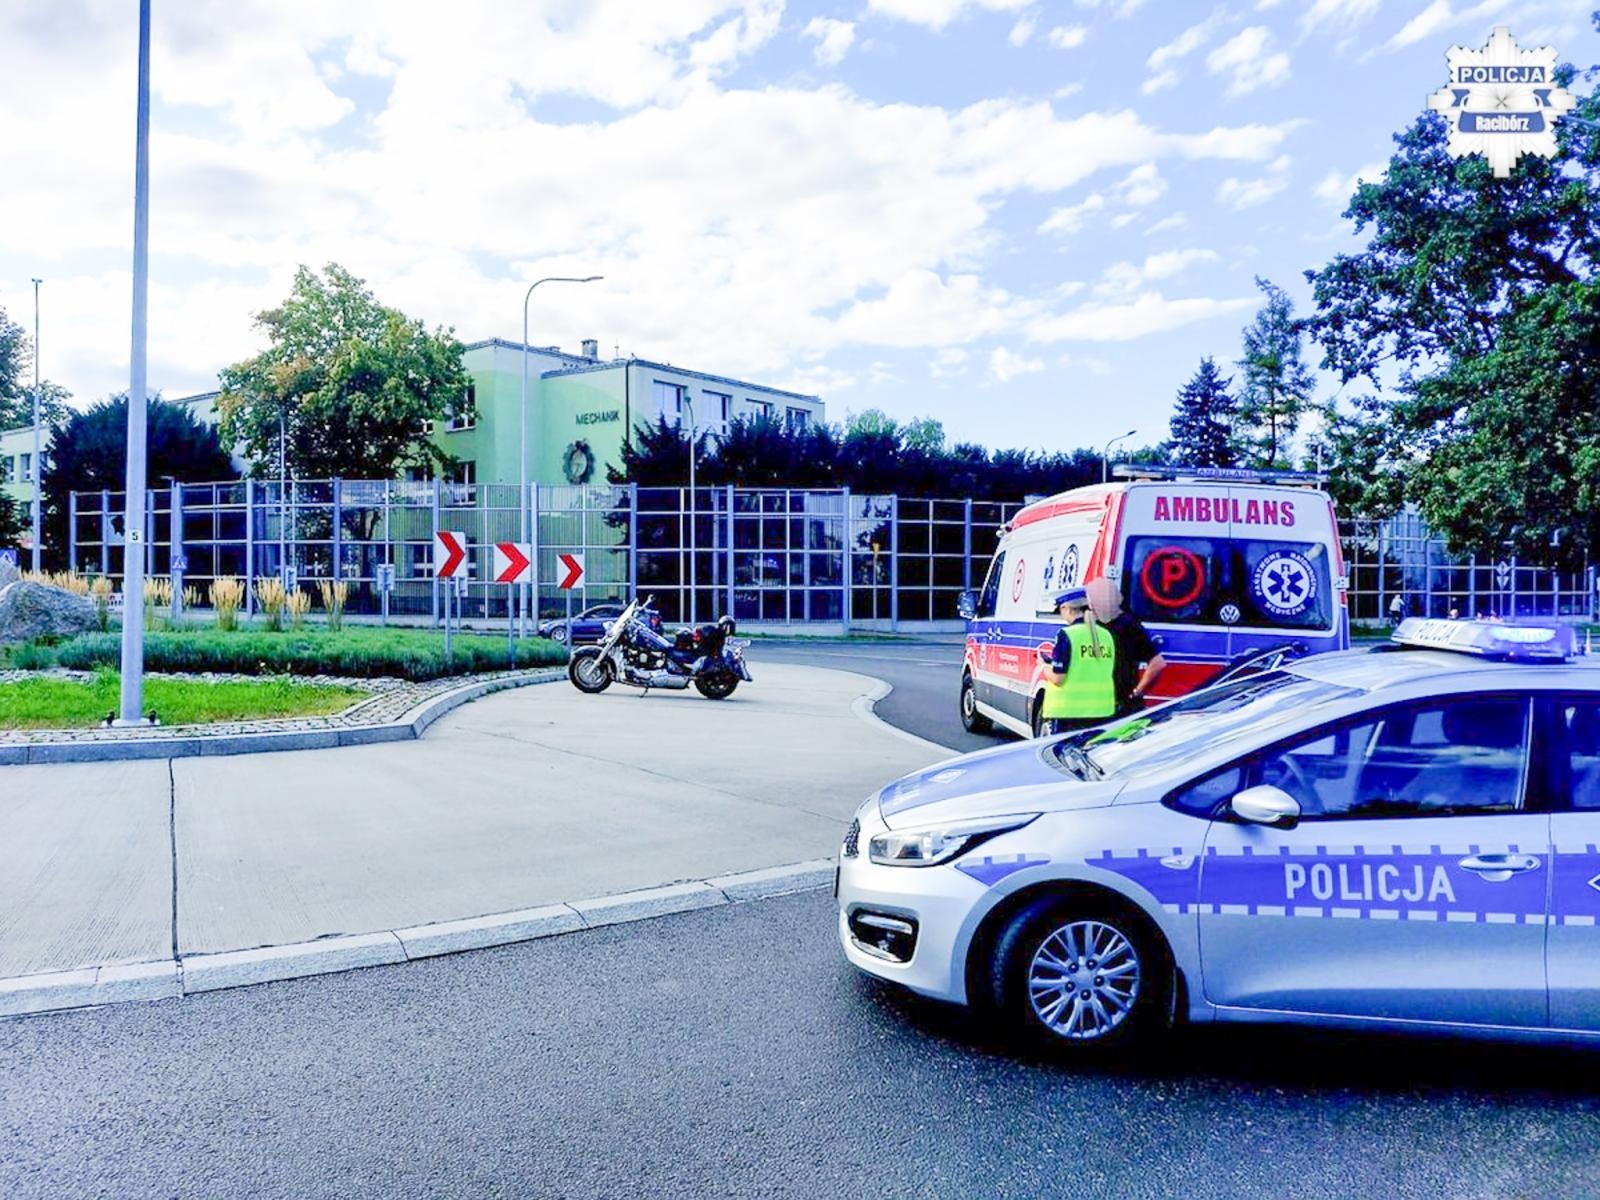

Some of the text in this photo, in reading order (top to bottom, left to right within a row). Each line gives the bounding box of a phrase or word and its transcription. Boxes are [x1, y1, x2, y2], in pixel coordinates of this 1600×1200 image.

[1153, 495, 1296, 528] AMBULANS
[1162, 557, 1188, 593] P
[1284, 863, 1456, 903] POLICJA
